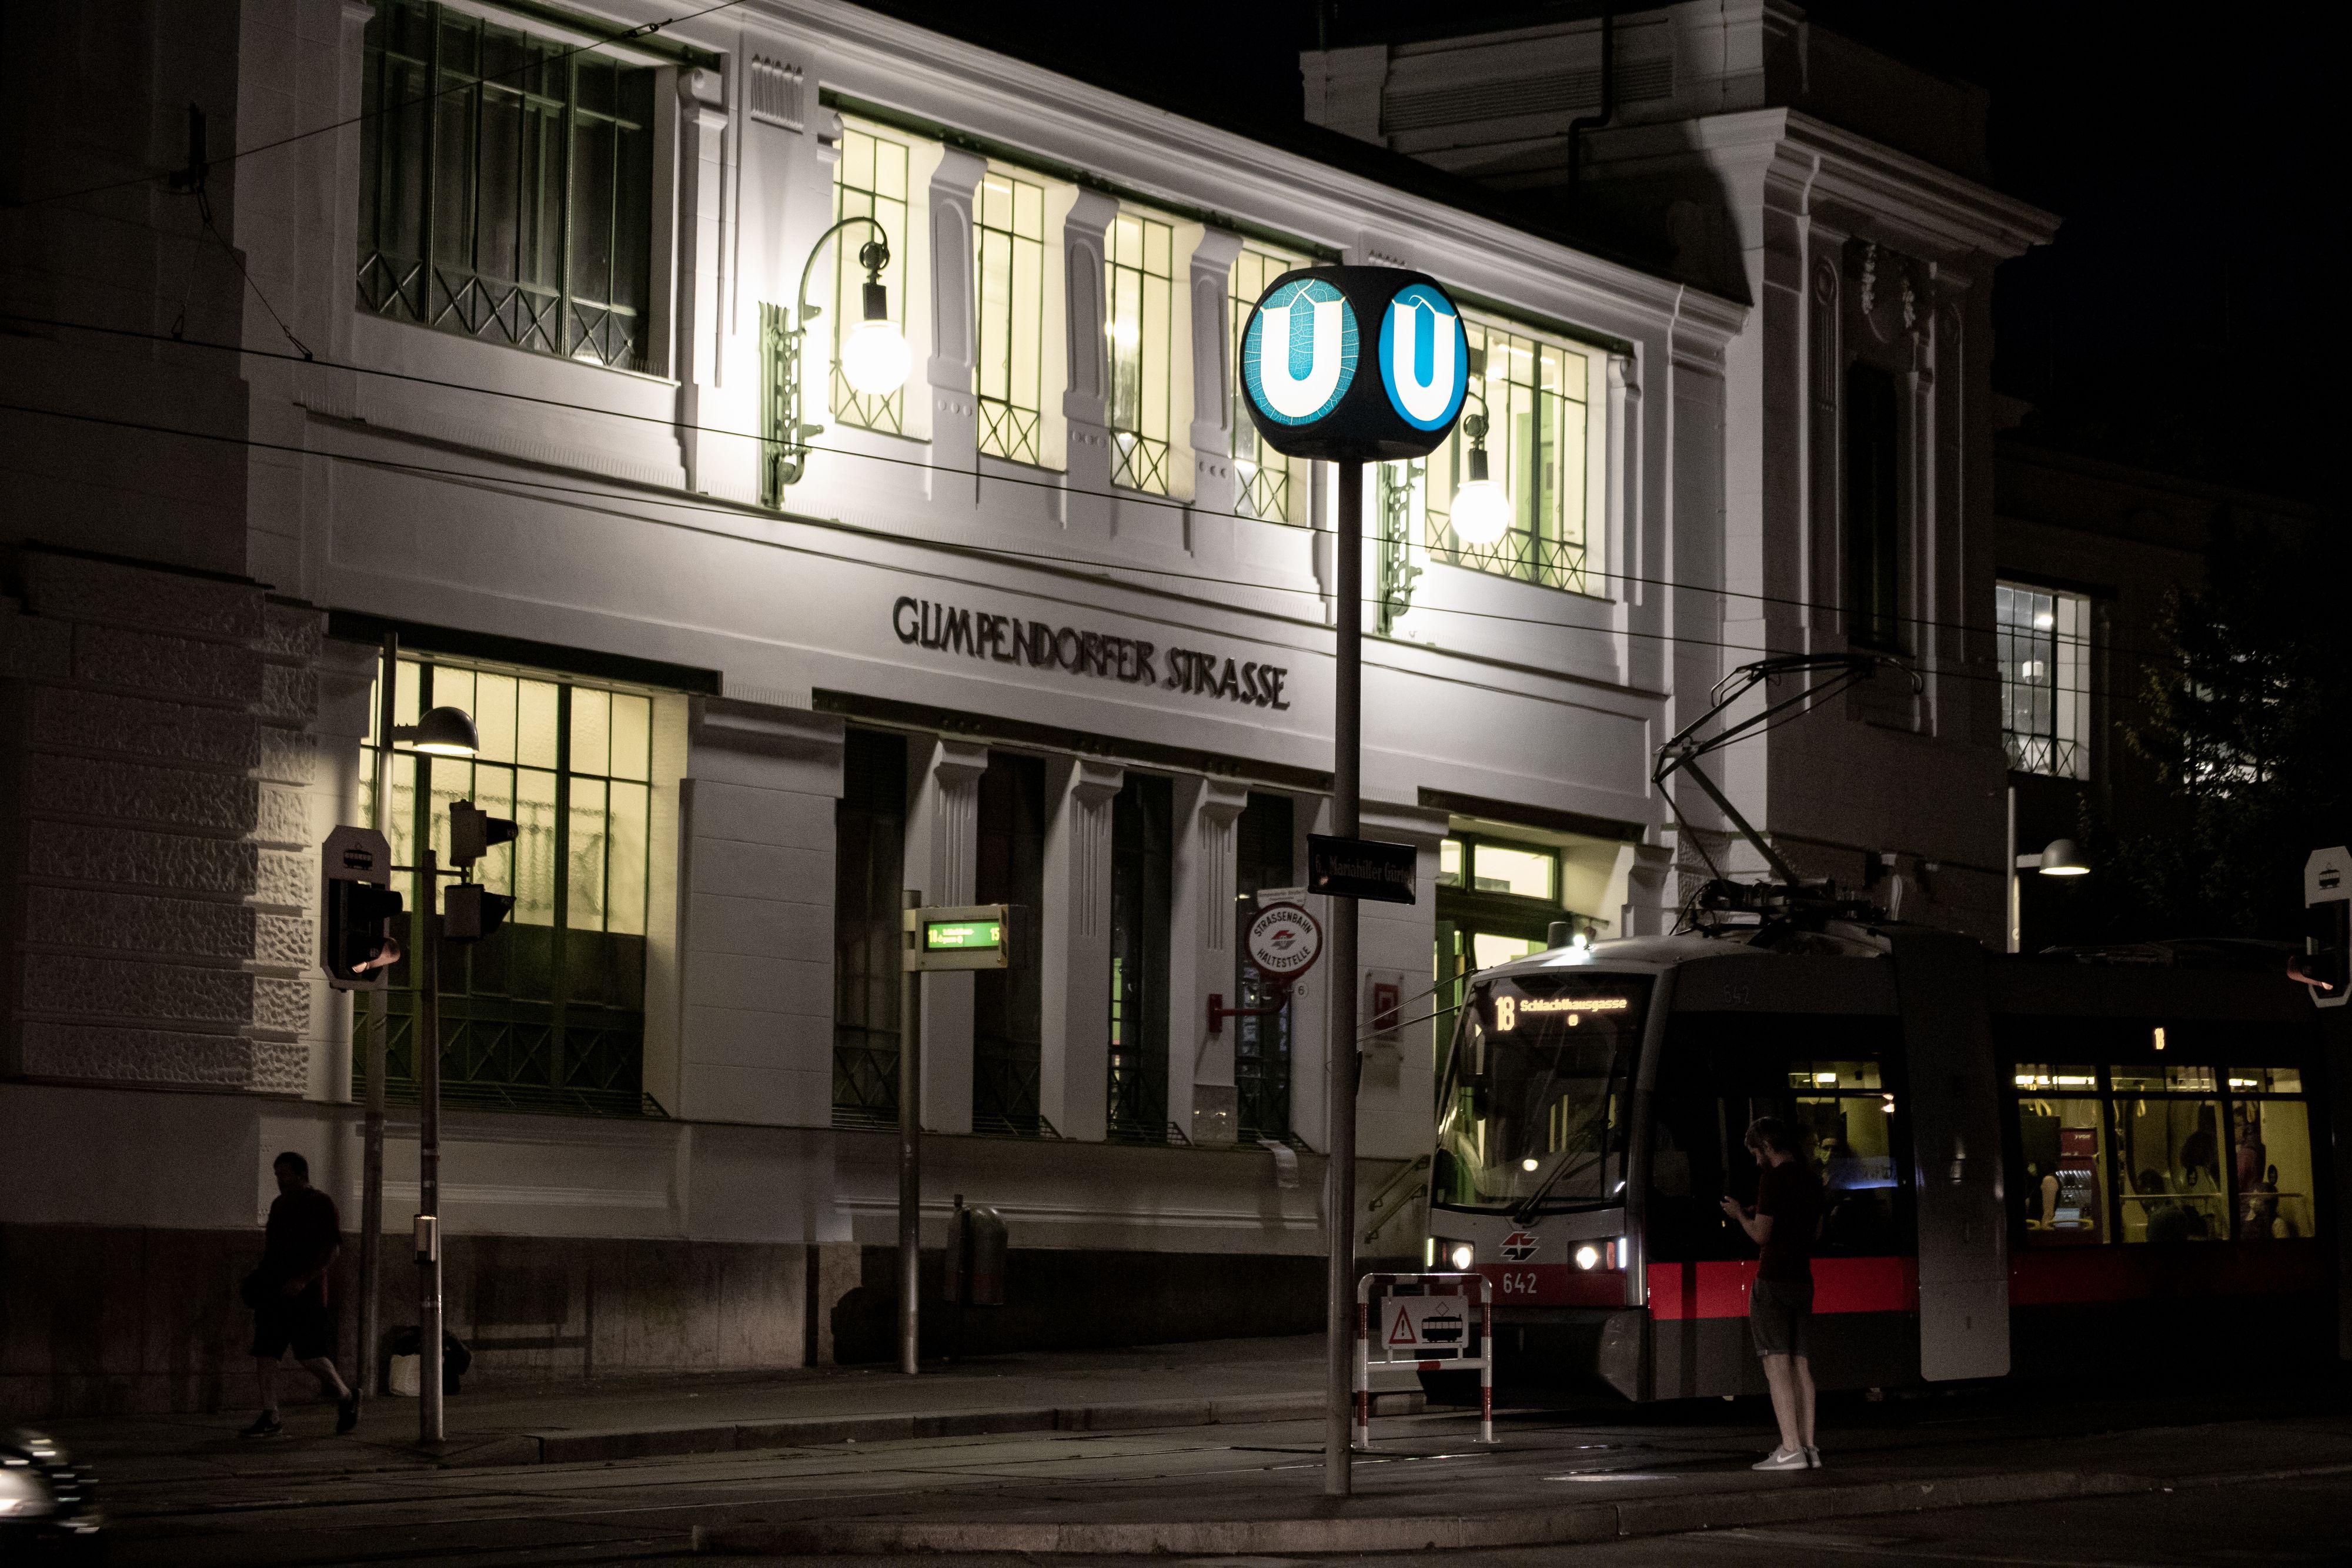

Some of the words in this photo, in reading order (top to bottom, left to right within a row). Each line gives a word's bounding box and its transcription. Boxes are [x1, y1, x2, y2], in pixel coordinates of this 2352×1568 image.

[1260, 299, 1345, 418] U
[1392, 301, 1456, 422] U
[893, 596, 1157, 686] GUMPENDORFER
[1167, 647, 1290, 710] STRASSE
[1329, 855, 1382, 881] Mariahilfer
[1384, 861, 1412, 884] Gürt
[1254, 911, 1313, 937] STRASSENBAHN
[1257, 946, 1311, 968] HALTESTELLE
[1298, 985, 1305, 995] 6
[1723, 984, 1751, 1005] 642
[1495, 996, 1515, 1031] 18
[1520, 998, 1627, 1012] Schlachthausgasse
[1502, 1272, 1538, 1294] 642
